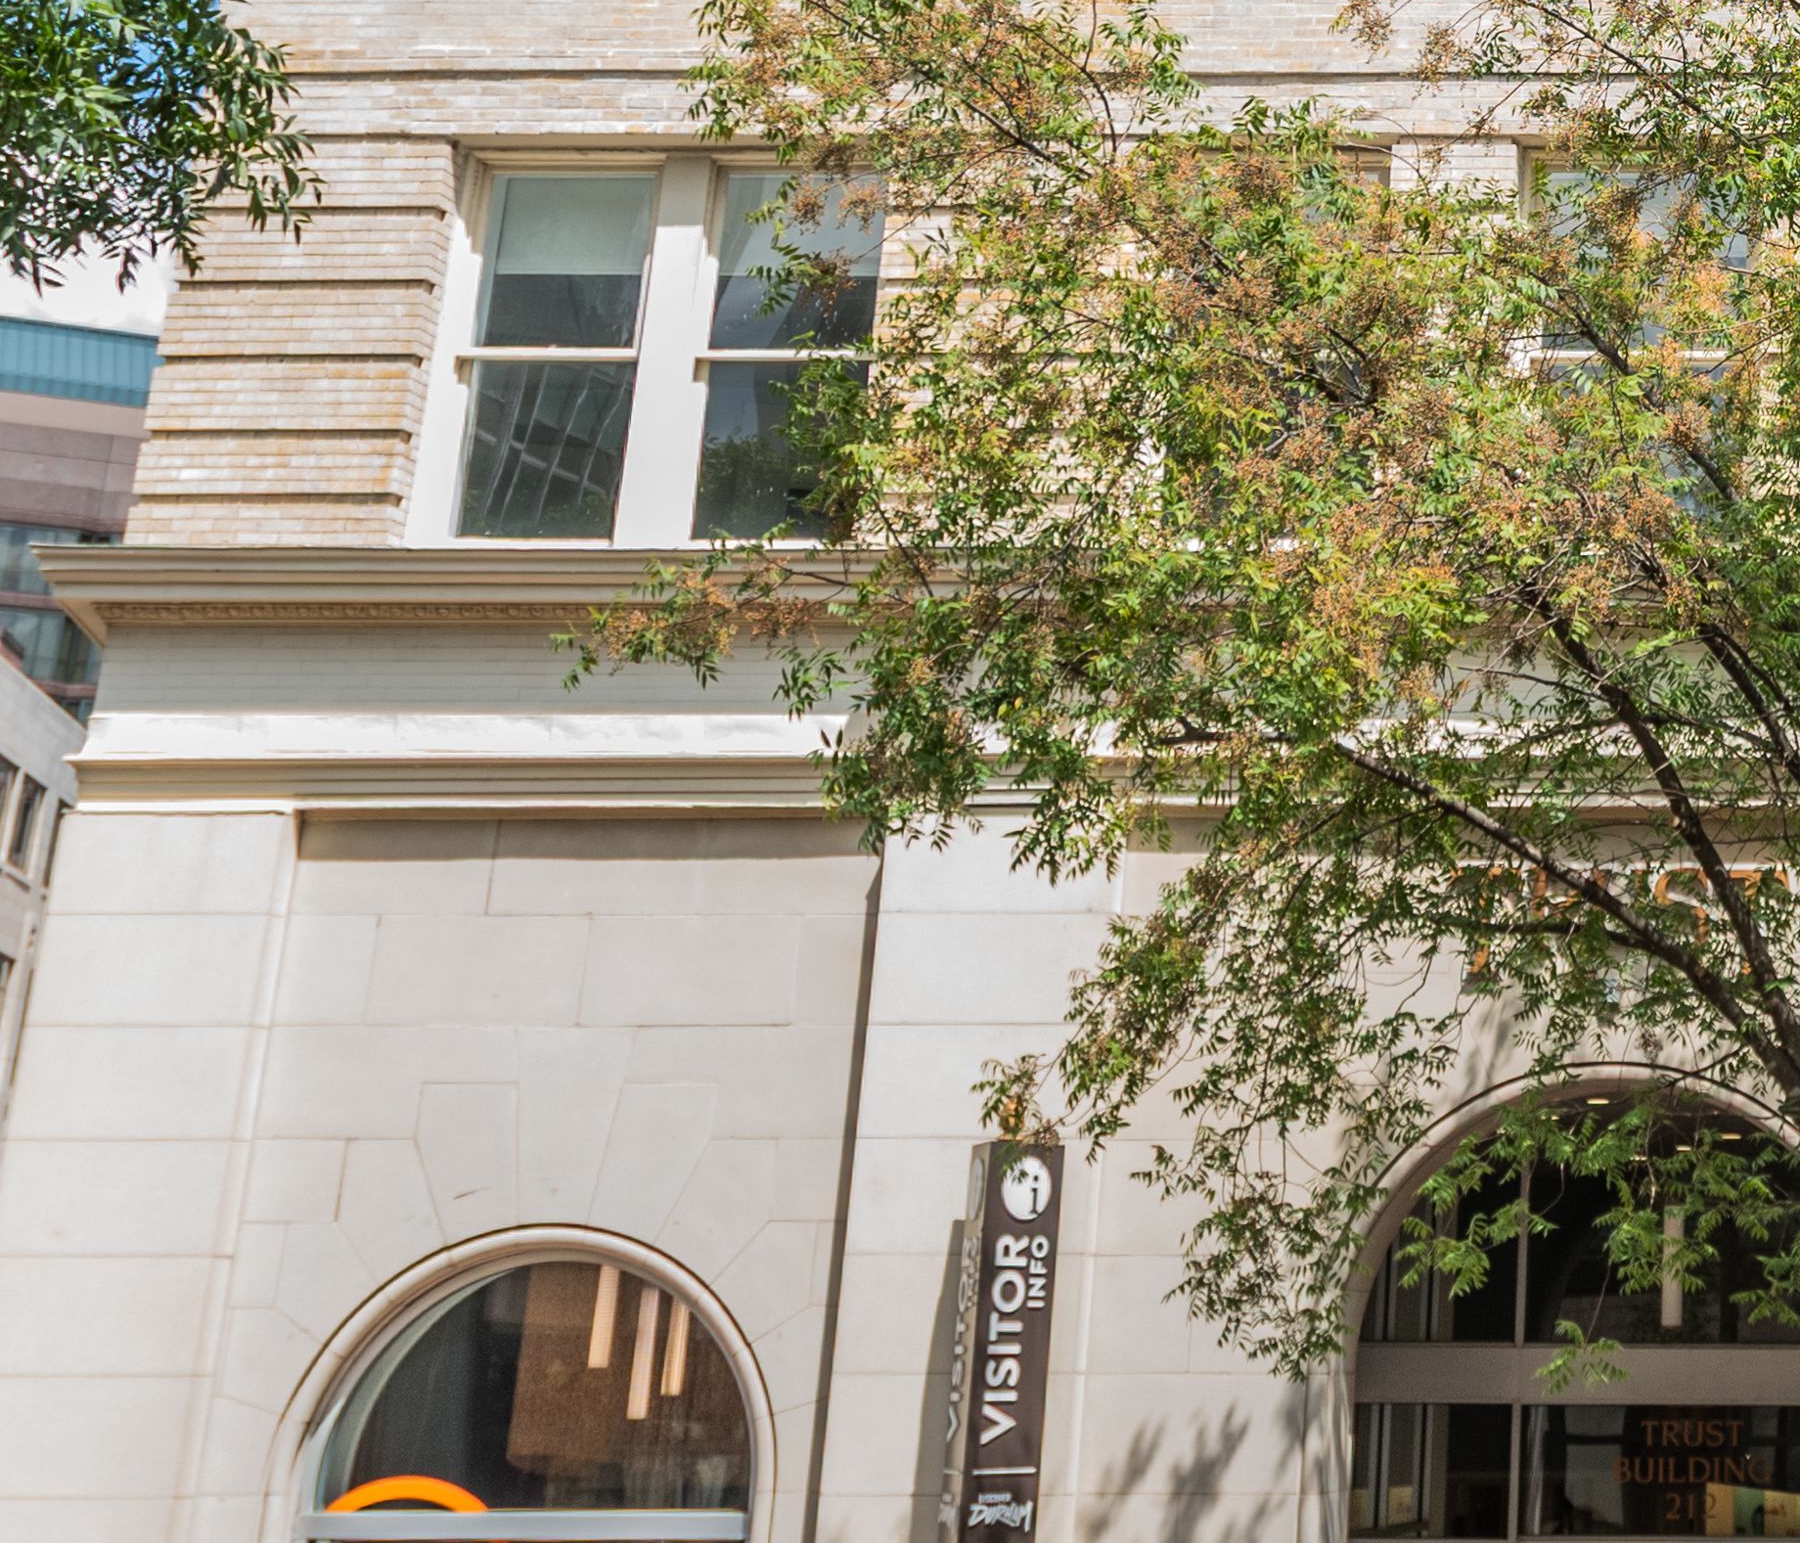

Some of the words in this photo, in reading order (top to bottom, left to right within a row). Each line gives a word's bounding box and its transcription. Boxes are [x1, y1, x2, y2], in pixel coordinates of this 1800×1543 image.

[1027, 1234, 1050, 1309] INFO
[979, 1233, 1029, 1446] VISITOR
[1640, 1420, 1744, 1447] TRUST
[1611, 1457, 1772, 1484] BUILDING
[1665, 1493, 1718, 1520] 212
